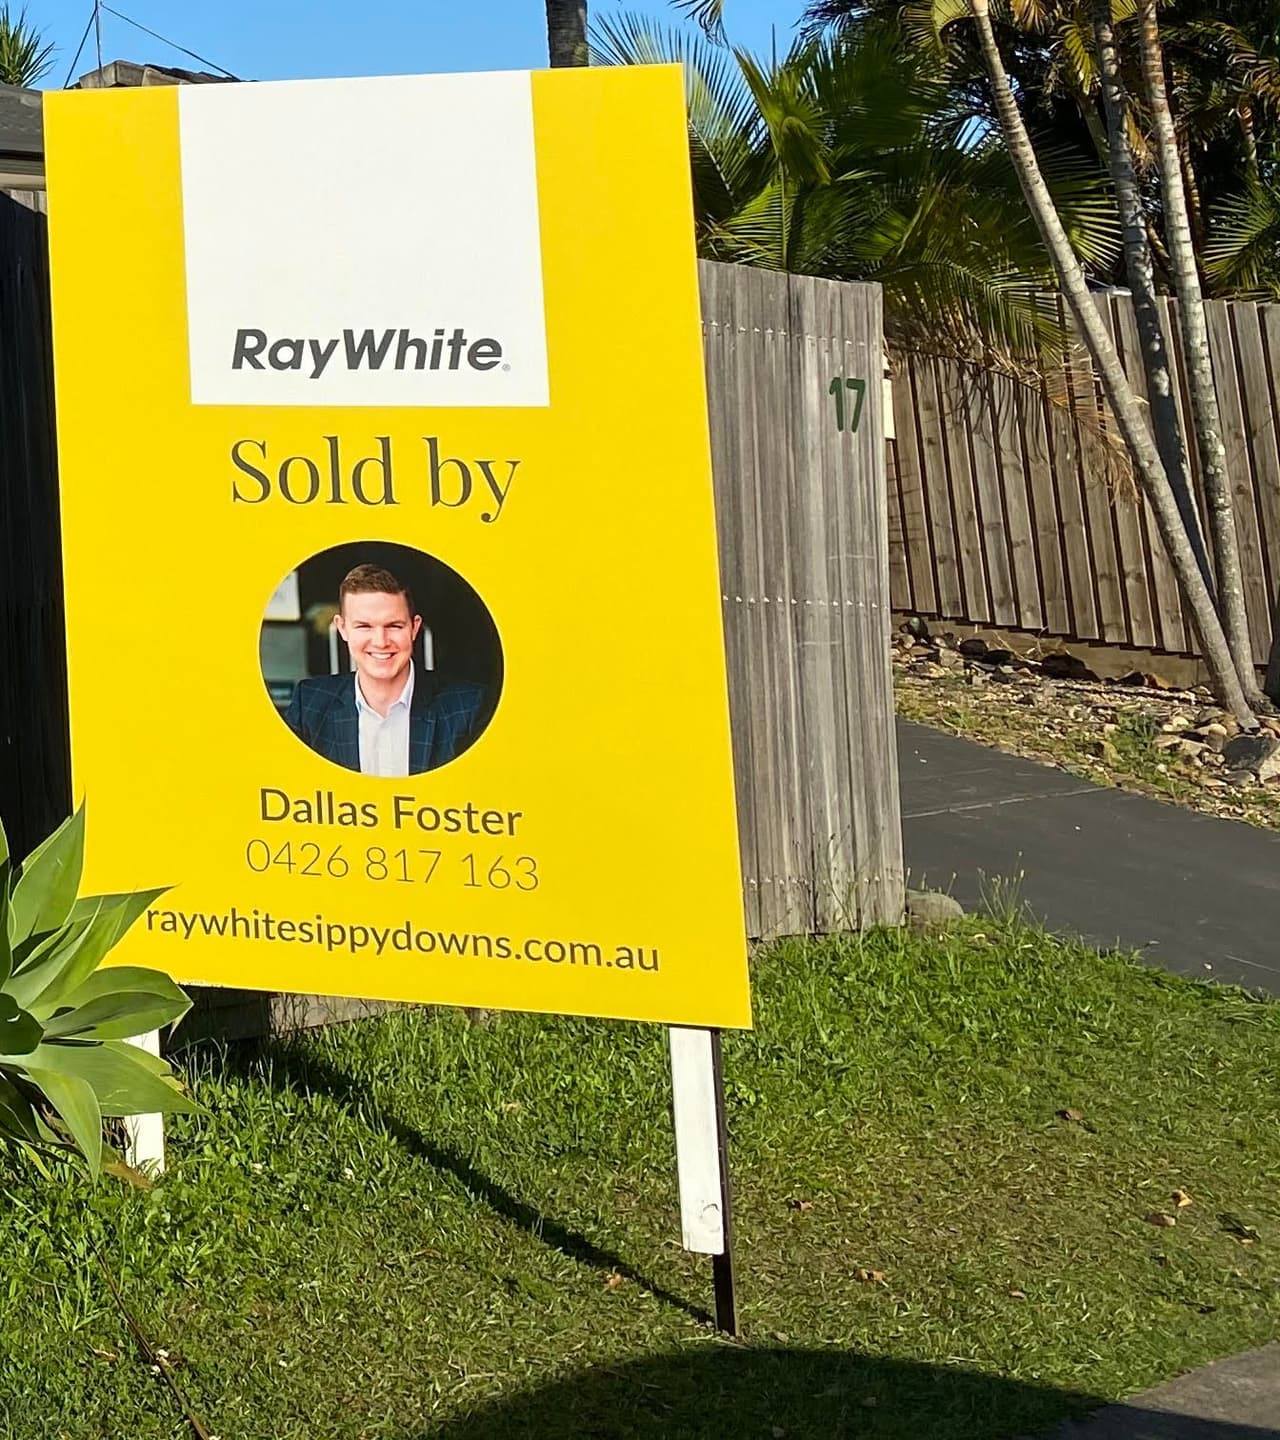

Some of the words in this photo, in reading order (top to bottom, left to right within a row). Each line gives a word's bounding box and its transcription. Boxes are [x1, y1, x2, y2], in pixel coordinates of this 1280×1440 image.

[231, 327, 503, 380] RayWhite
[828, 376, 866, 433] 17
[231, 435, 401, 506] Sold
[421, 436, 522, 524] by
[260, 787, 379, 828] Dallas
[393, 795, 523, 837] Foster
[246, 839, 349, 878] 0426
[365, 846, 442, 884] 817
[461, 853, 539, 892] 163
[146, 907, 659, 972] raywhitesippydowns.com.au
